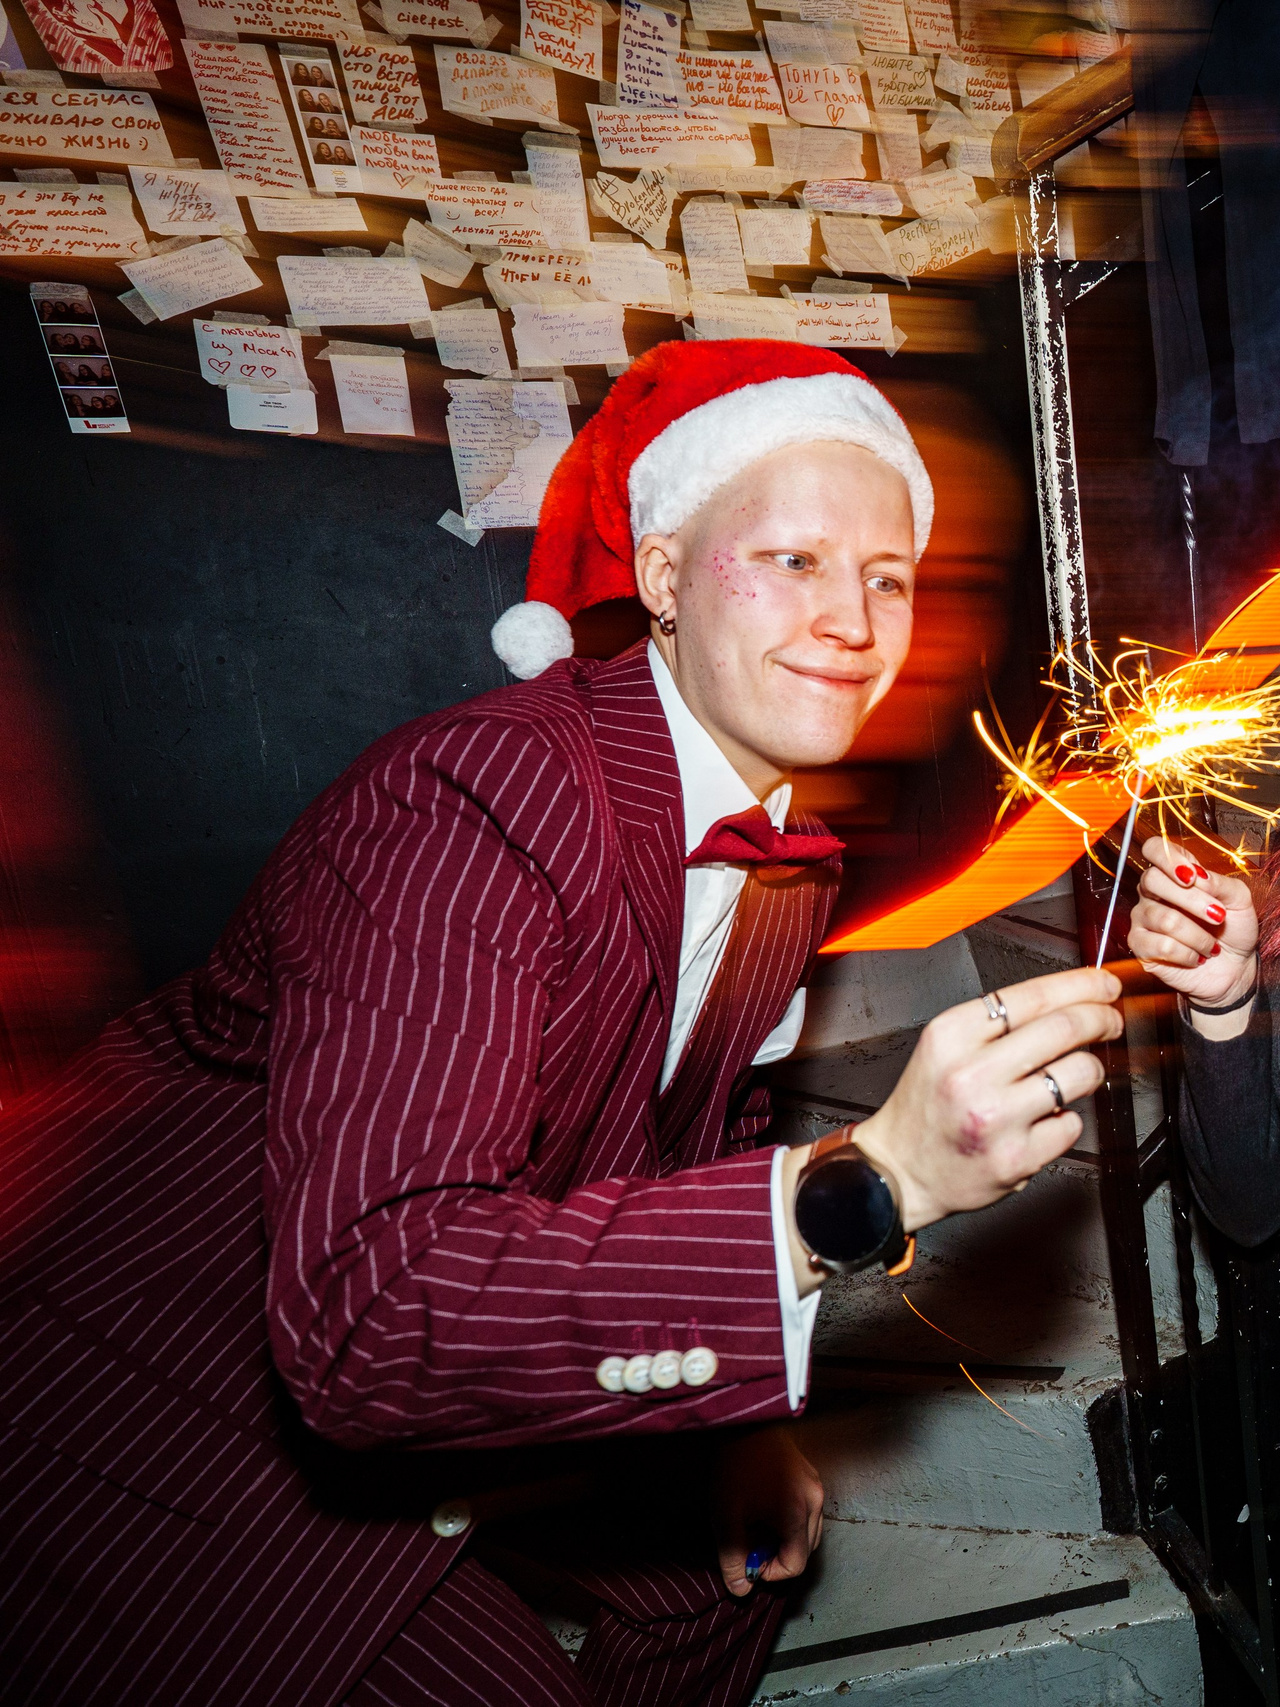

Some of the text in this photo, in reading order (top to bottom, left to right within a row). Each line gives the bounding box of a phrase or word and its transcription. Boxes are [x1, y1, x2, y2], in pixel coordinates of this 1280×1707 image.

[52, 91, 145, 107] СЕЙЧАС
[112, 116, 161, 130] СВОЮ
[511, 230, 546, 239] ДРУГИ
